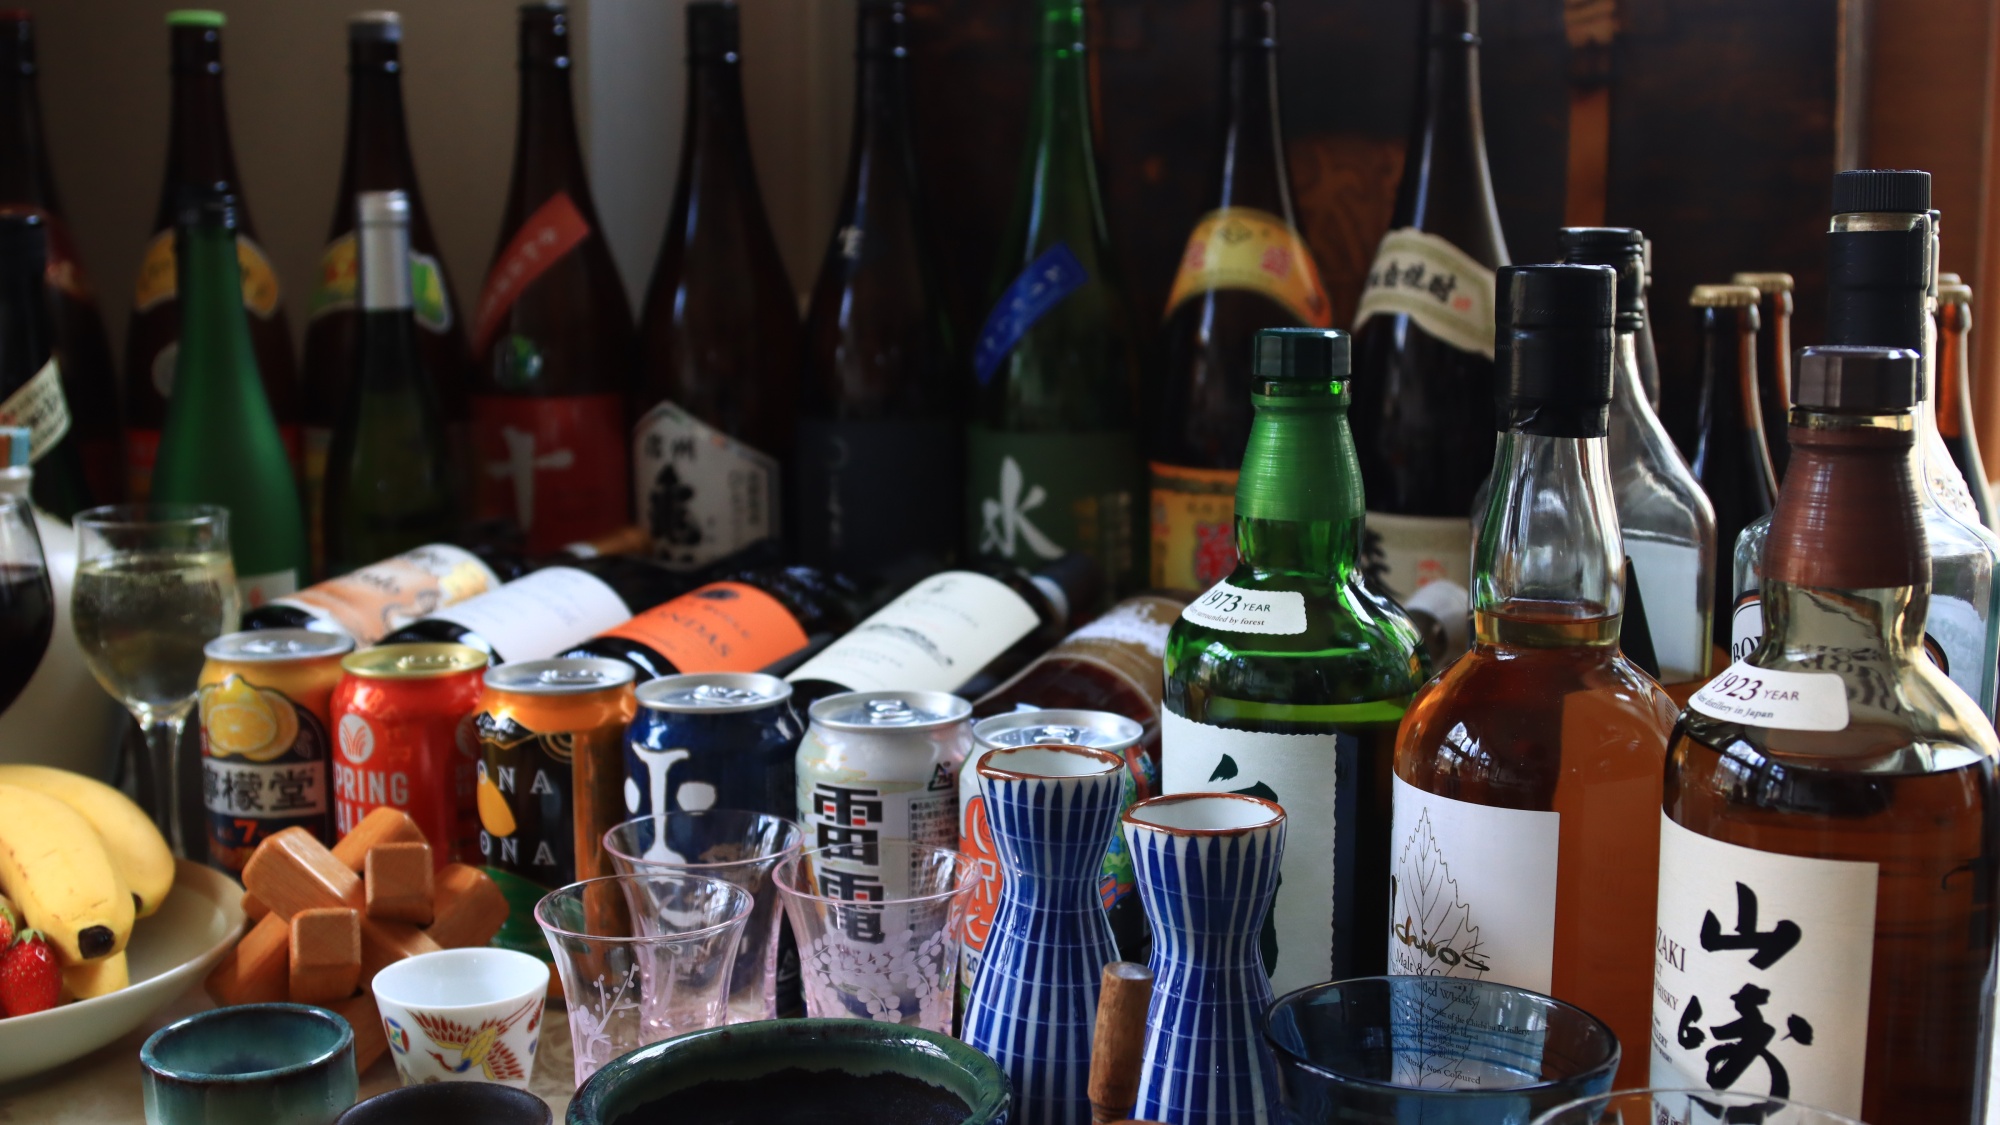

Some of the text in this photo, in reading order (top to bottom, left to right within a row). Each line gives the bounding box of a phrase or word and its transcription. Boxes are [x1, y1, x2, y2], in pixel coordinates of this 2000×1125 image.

[978, 454, 1067, 561] 水
[1201, 589, 1243, 613] 1973
[1242, 602, 1271, 613] YEAR
[1195, 610, 1265, 626] surrounded by forest
[1711, 672, 1764, 702] 1923
[1764, 689, 1800, 702] YEAR
[1704, 697, 1774, 720] distillery in Japan
[333, 761, 410, 806] PRING
[813, 781, 886, 945] 雷電
[1395, 947, 1415, 973] Malt
[1439, 987, 1480, 1010] Whisky
[1443, 1068, 1481, 1085] Coloured
